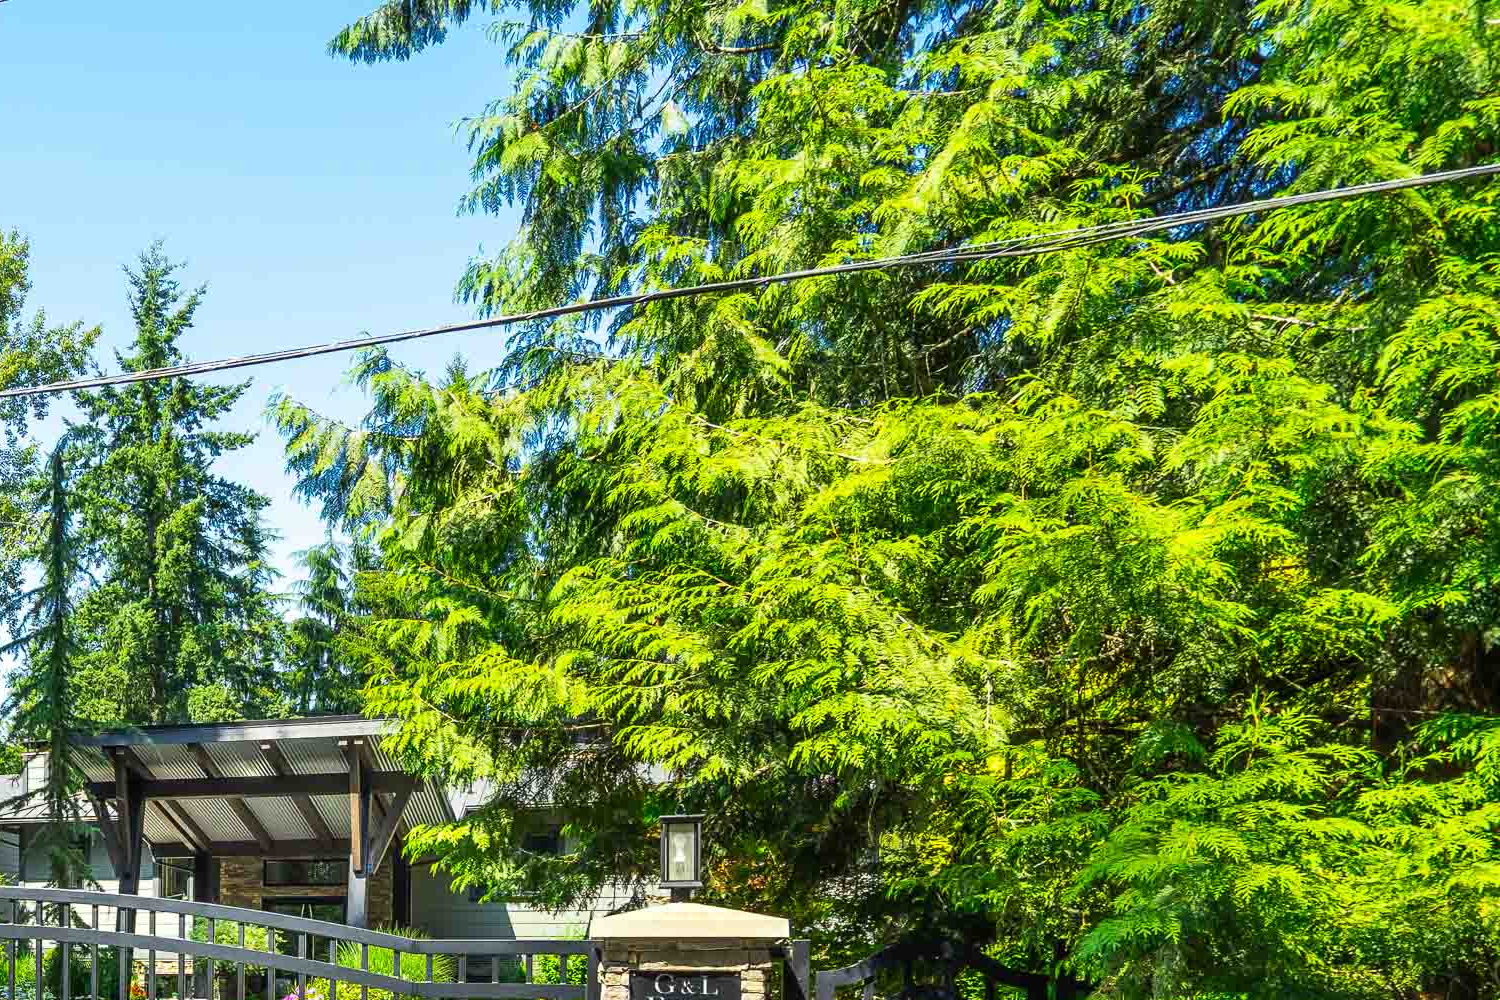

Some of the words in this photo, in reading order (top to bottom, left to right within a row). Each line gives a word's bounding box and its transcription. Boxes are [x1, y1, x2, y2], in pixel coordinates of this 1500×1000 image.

[654, 974, 676, 995] G
[680, 979, 696, 995] &
[700, 975, 719, 995] L
